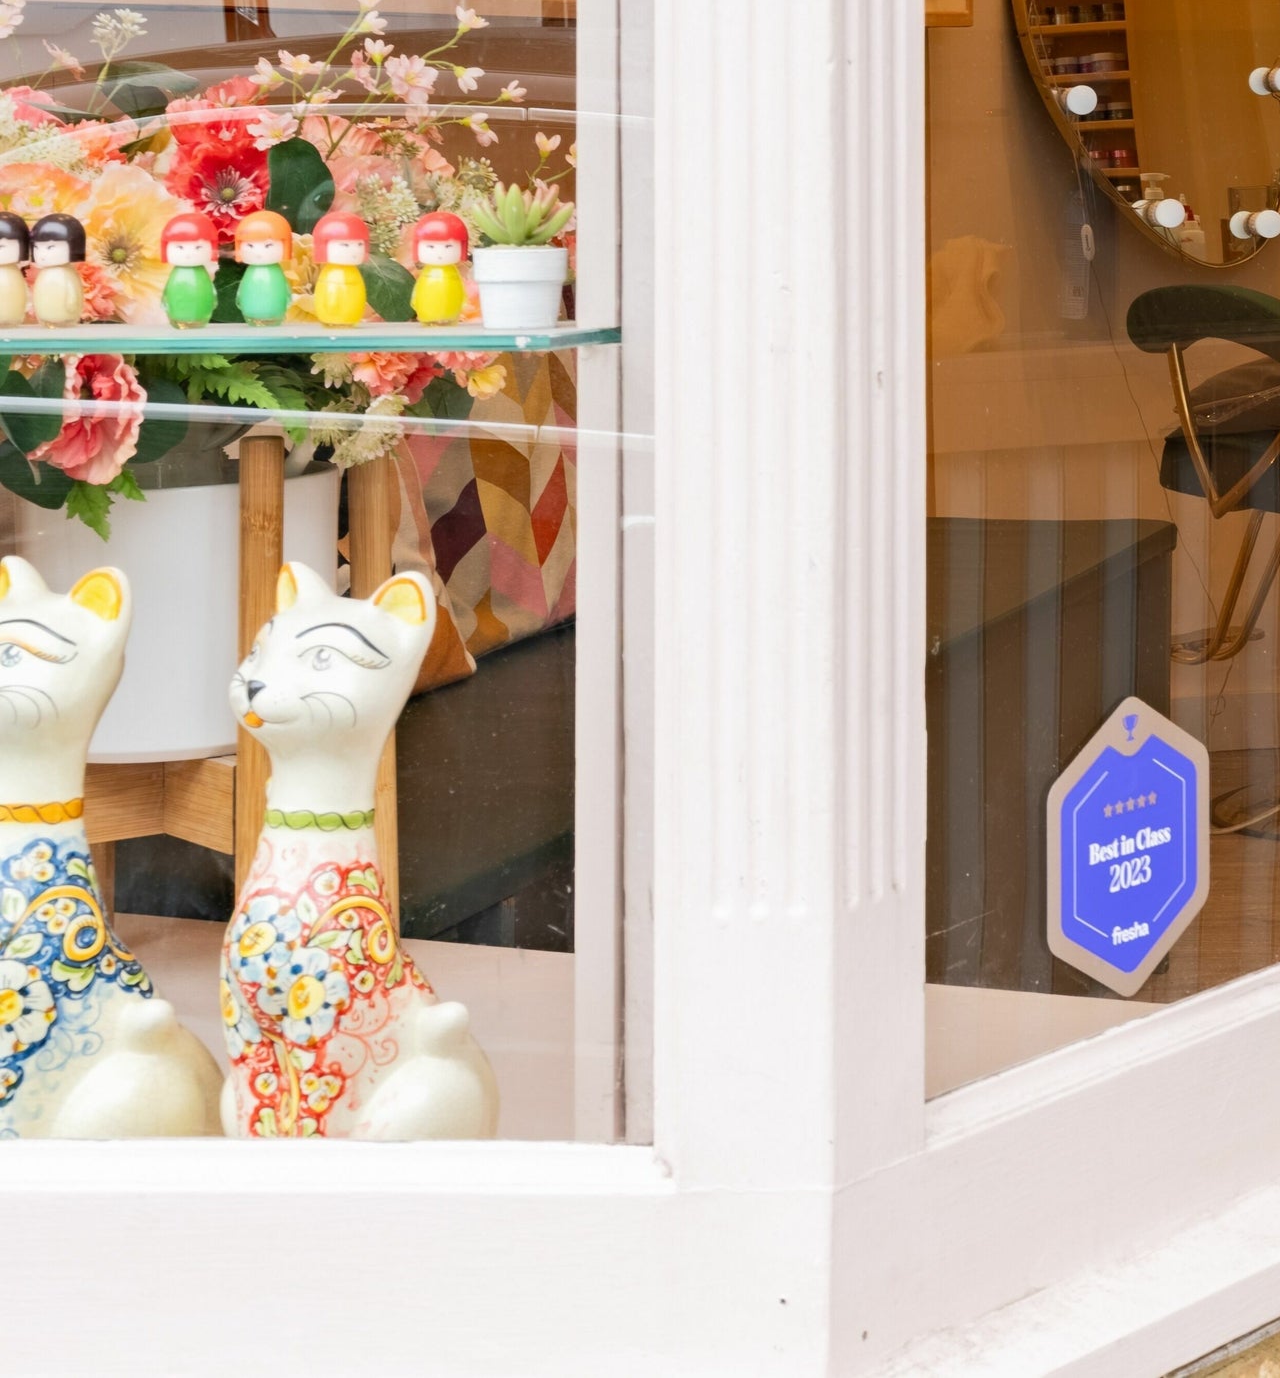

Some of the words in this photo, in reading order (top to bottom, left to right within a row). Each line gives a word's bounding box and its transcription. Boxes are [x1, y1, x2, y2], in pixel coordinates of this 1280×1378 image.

[1088, 837, 1120, 866] Best
[1121, 835, 1135, 856] in
[1136, 826, 1171, 851] Class
[1109, 855, 1152, 894] 2023
[1111, 921, 1150, 946] fresha
